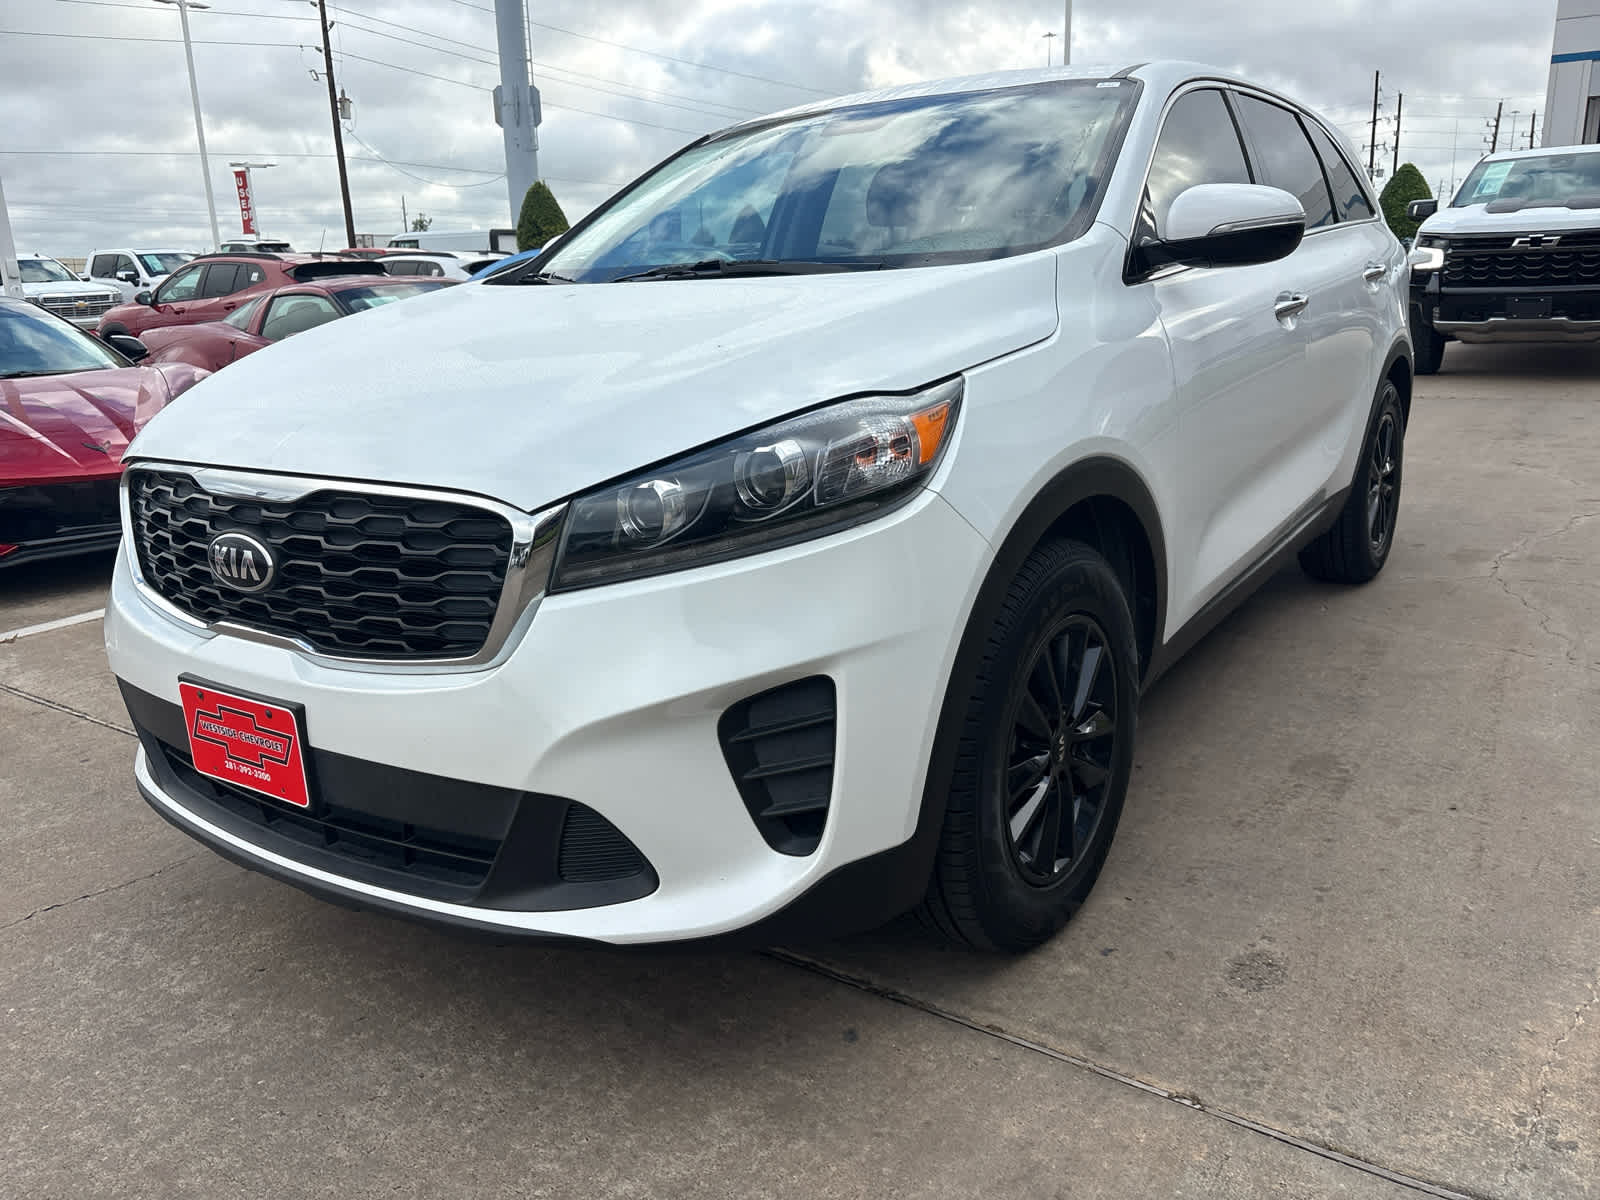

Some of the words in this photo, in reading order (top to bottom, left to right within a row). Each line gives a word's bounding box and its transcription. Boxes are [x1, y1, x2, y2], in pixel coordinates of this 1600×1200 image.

[237, 177, 248, 220] USED
[214, 544, 260, 581] KIA
[200, 720, 238, 739] WESTSIDE
[238, 731, 283, 753] CHEVROLET
